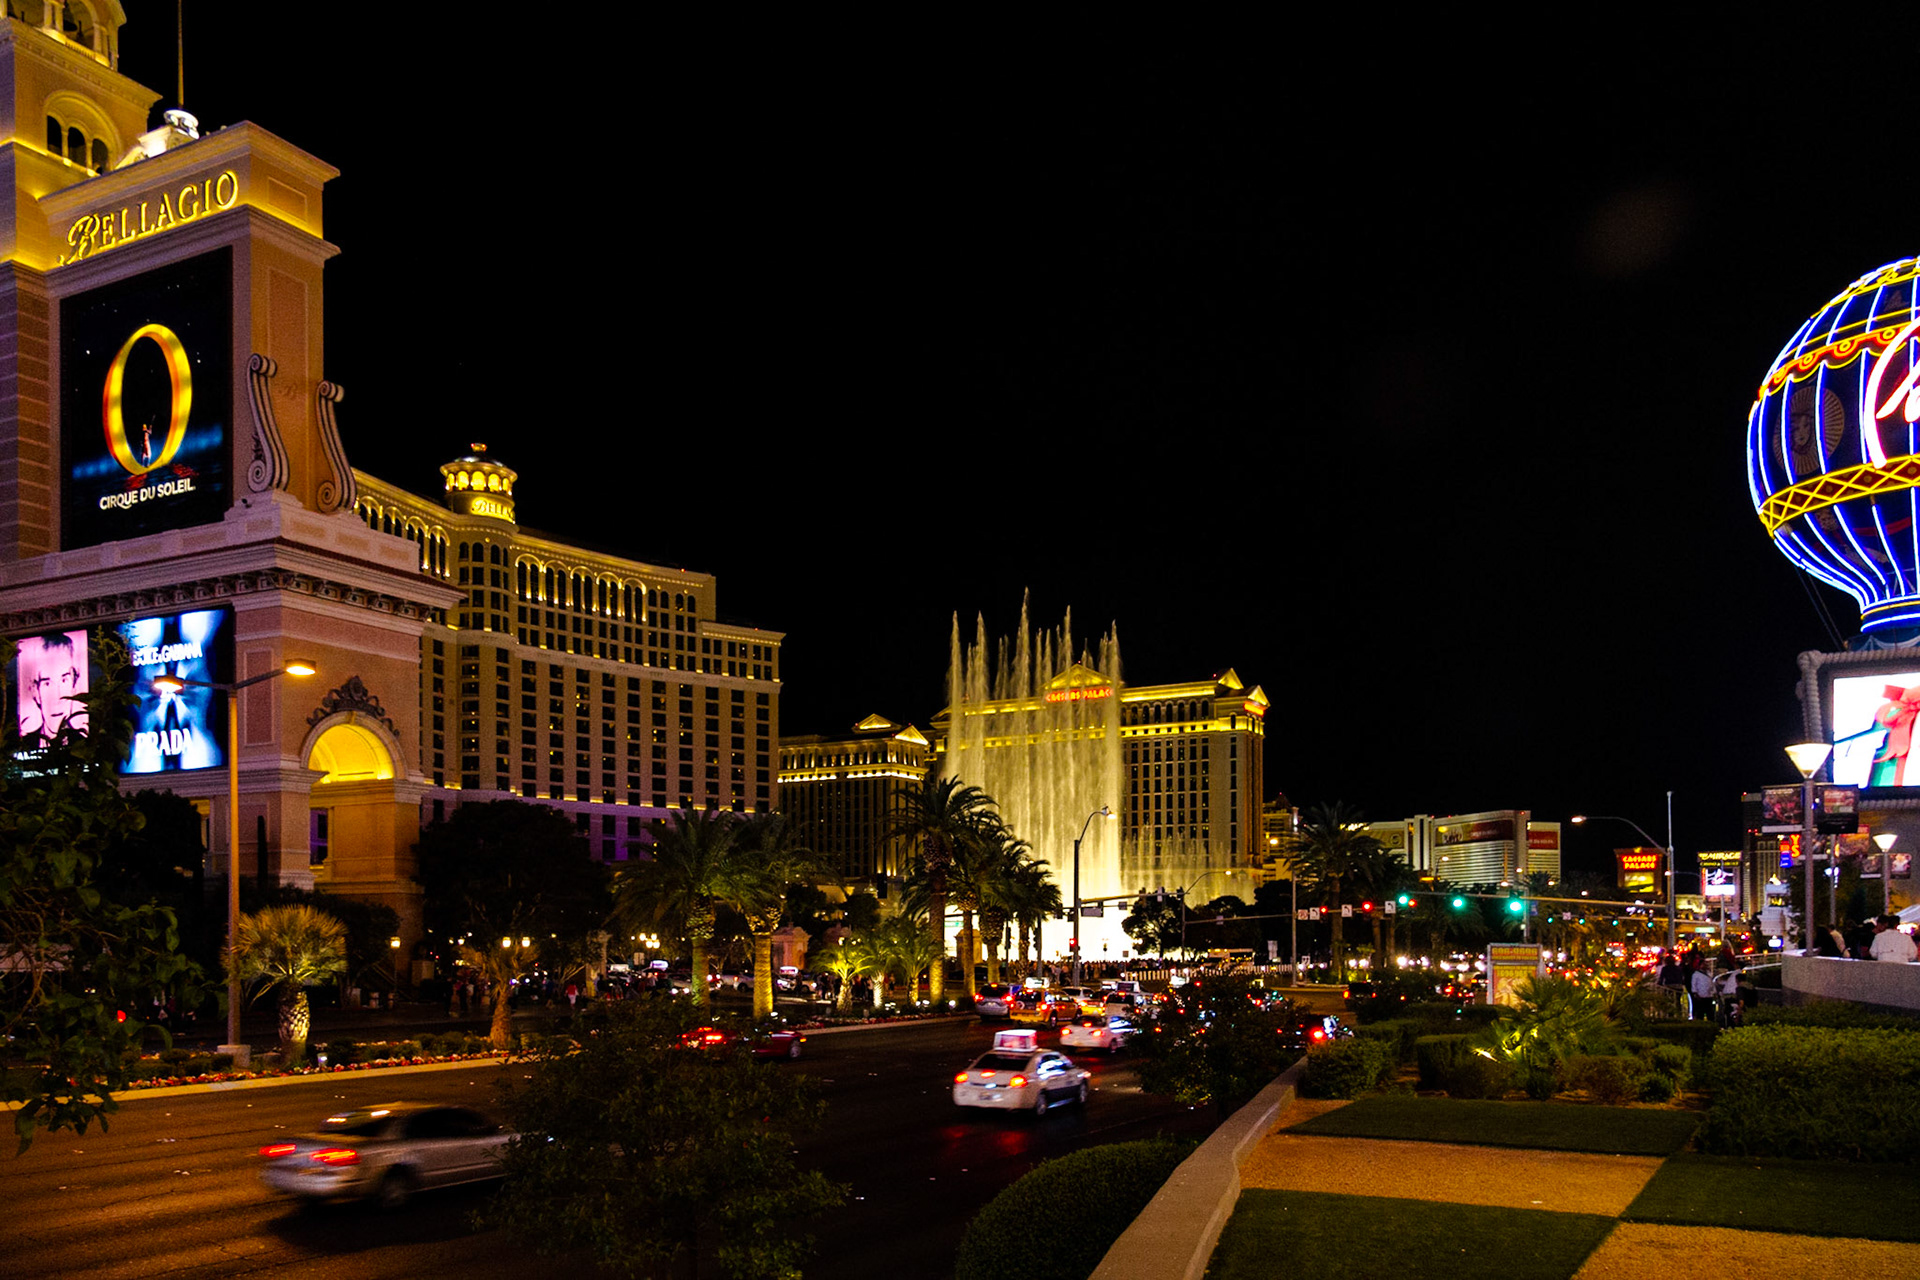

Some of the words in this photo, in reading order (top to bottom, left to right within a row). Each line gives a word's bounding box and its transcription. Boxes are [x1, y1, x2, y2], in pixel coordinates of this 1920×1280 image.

[57, 170, 240, 267] BELLAGIO
[99, 490, 138, 511] CIRQUE
[140, 486, 155, 503] DU
[157, 478, 196, 498] SOLEIL
[135, 728, 193, 758] PRADA
[1622, 855, 1657, 863] CAESARS
